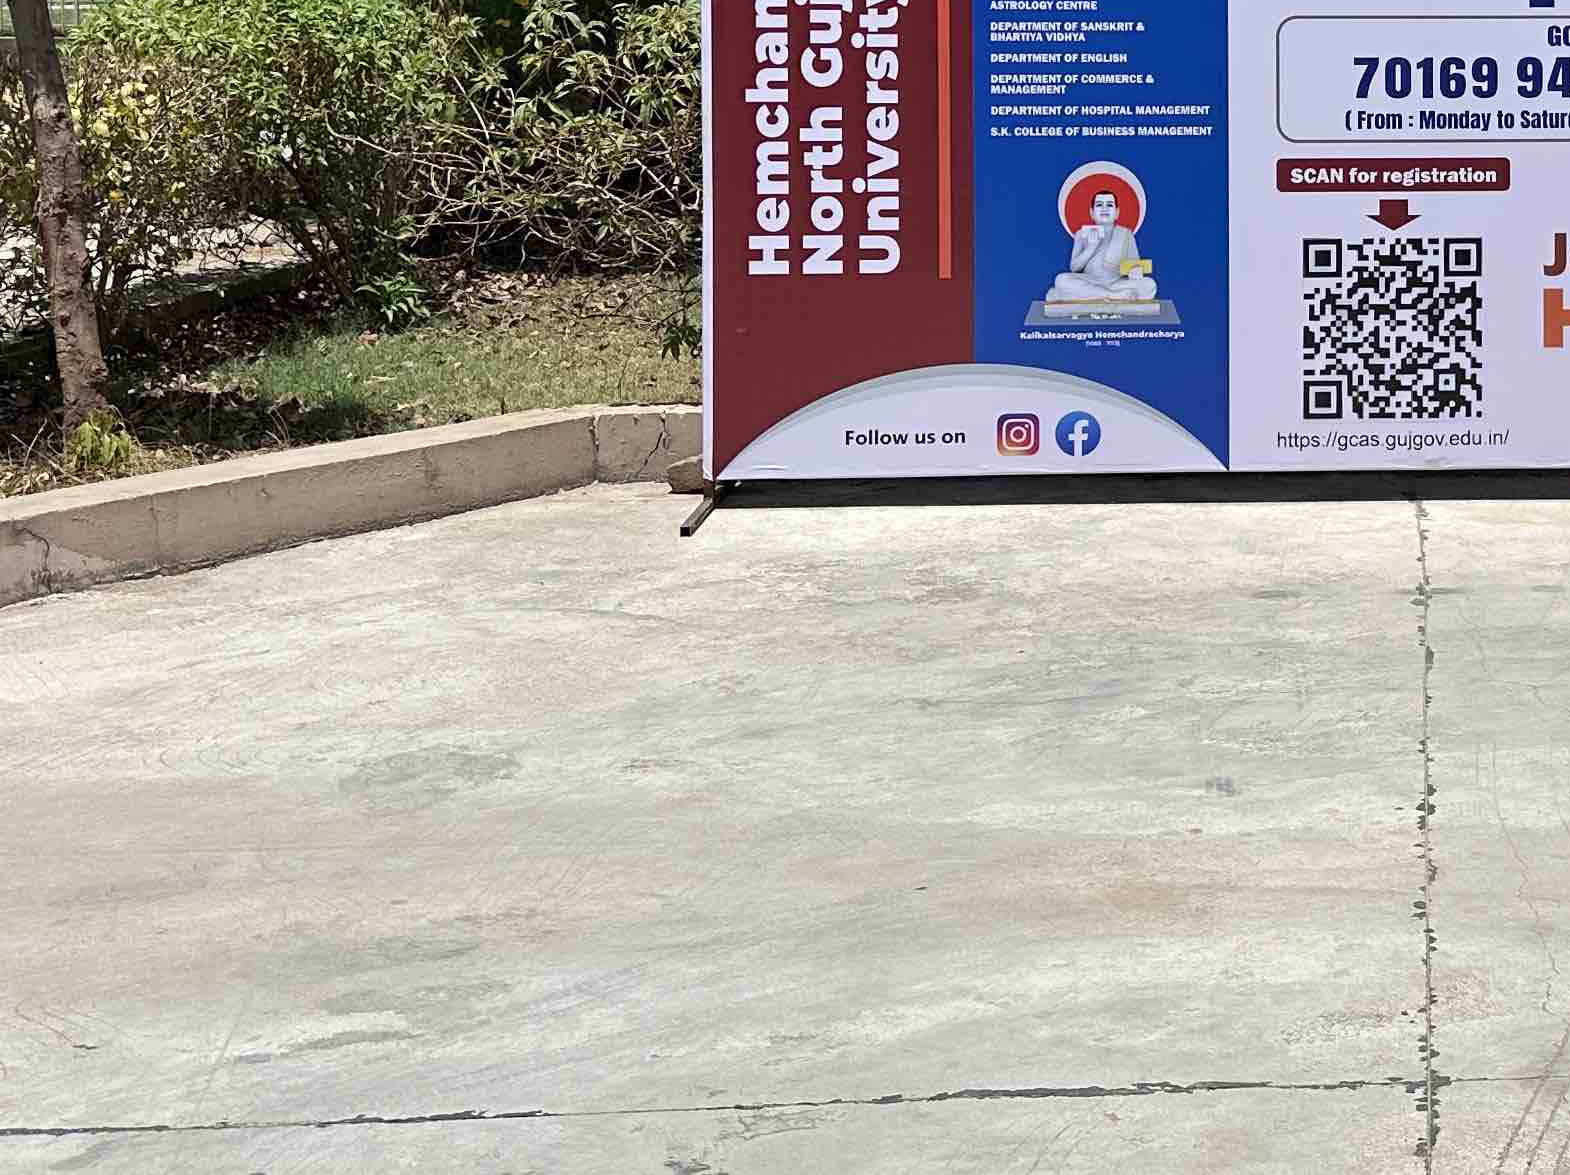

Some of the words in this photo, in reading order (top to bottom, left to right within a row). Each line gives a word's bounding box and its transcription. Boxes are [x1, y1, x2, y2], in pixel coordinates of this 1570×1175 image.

[989, 0, 1054, 11] ASTROLOGY
[1055, 0, 1098, 11] CENTRE
[990, 21, 1062, 32] DEPARTMENT
[1063, 21, 1079, 32] OF
[1080, 21, 1135, 32] SANSKRIT
[1135, 21, 1145, 32] &
[990, 31, 1044, 42] BHARTIYA
[1045, 31, 1086, 42] VIDHYA
[990, 53, 1063, 63] DEPARTMENT
[1063, 53, 1079, 63] OF
[1080, 53, 1128, 63] ENGLISH
[990, 74, 1063, 84] DEPARTMENT
[1063, 74, 1079, 84] OF
[1080, 74, 1144, 84] COMMERCE
[1145, 74, 1154, 84] &
[1354, 57, 1498, 98] 70169
[990, 84, 1067, 95] MANAGEMENT
[990, 105, 1063, 116] DEPARTMENT
[1063, 105, 1080, 116] OF
[1081, 105, 1134, 116] HOSPITAL
[1135, 105, 1211, 115] MANAGEMENT
[1358, 111, 1402, 129] From
[1420, 111, 1491, 131] Monday
[1497, 111, 1514, 128] to
[990, 126, 1012, 137] S.K.
[1014, 126, 1063, 137] COLLEGE
[1064, 126, 1080, 137] OF
[1081, 126, 1136, 137] BUSINESS
[1137, 126, 1213, 136] MANAGEMENT
[1291, 168, 1343, 183] SCAN
[1349, 168, 1377, 183] for
[1383, 167, 1496, 186] registration
[800, 106, 844, 275] North
[846, 430, 908, 445] Follow
[915, 432, 936, 445] us
[941, 432, 966, 444] on
